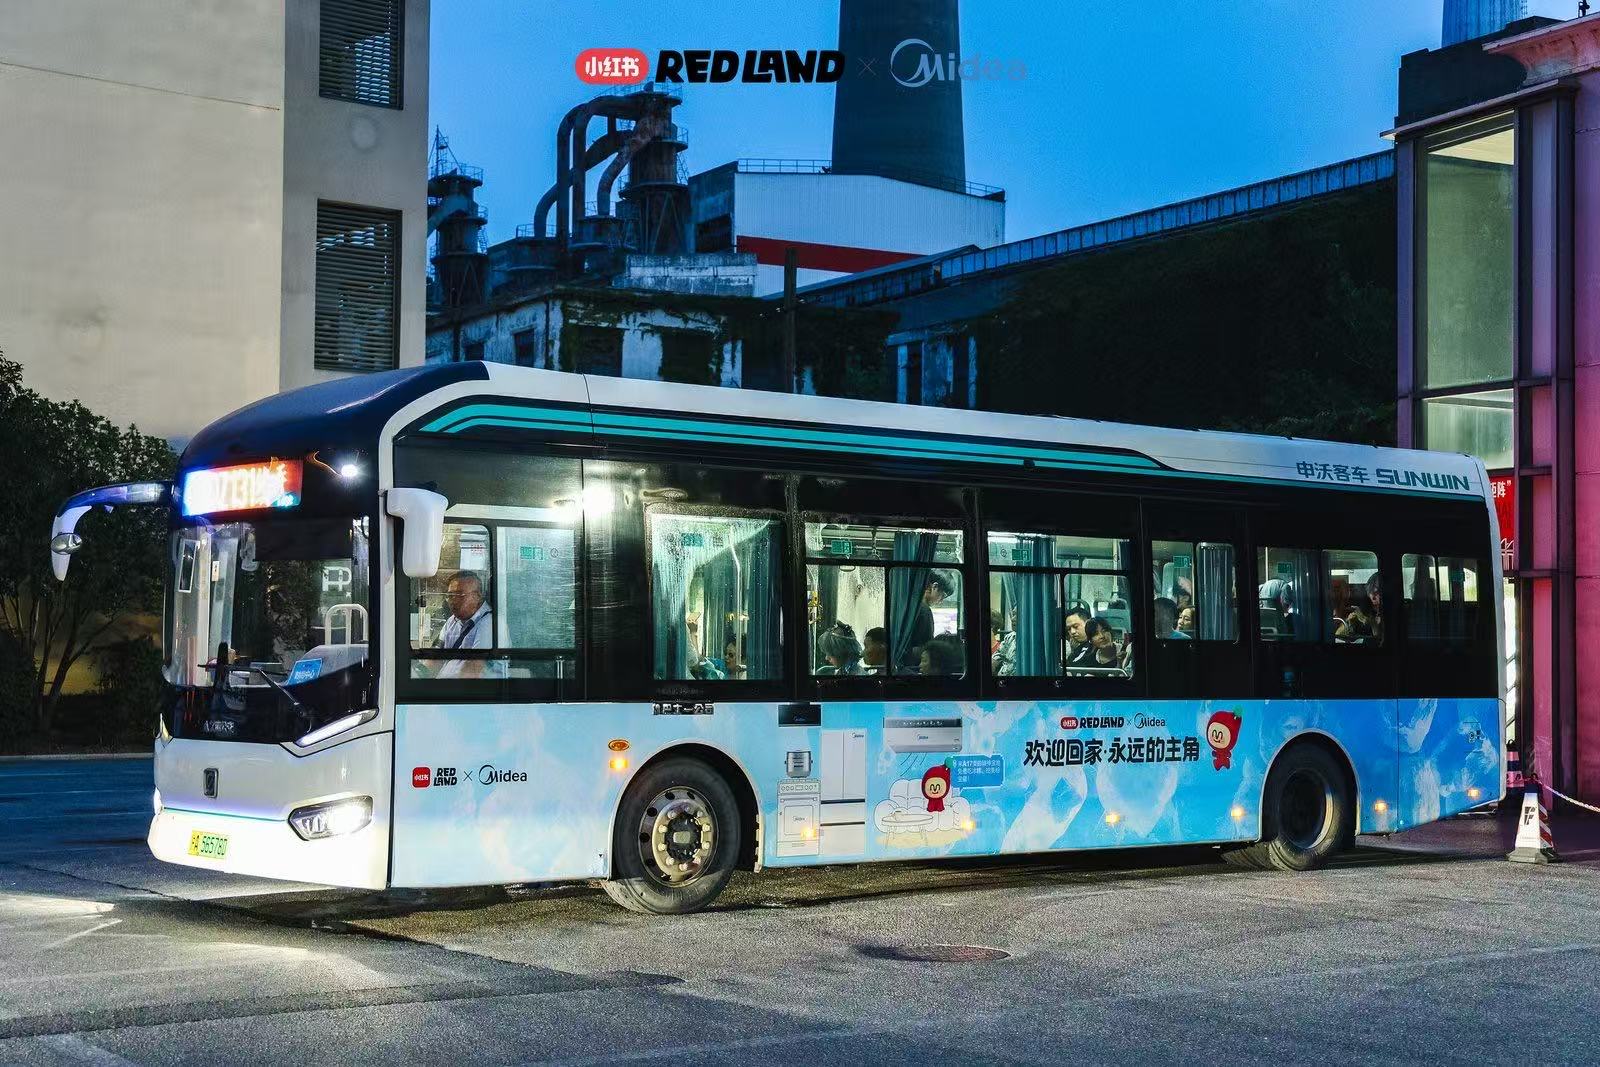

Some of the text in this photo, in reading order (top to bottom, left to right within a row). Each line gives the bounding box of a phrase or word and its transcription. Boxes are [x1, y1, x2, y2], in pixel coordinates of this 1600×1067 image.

[1296, 461, 1470, 491] 申沃客车 SUNWIN
[1134, 712, 1166, 729] Midea
[436, 768, 457, 777] RED
[478, 764, 527, 785] Midea
[433, 777, 458, 787] LAND
